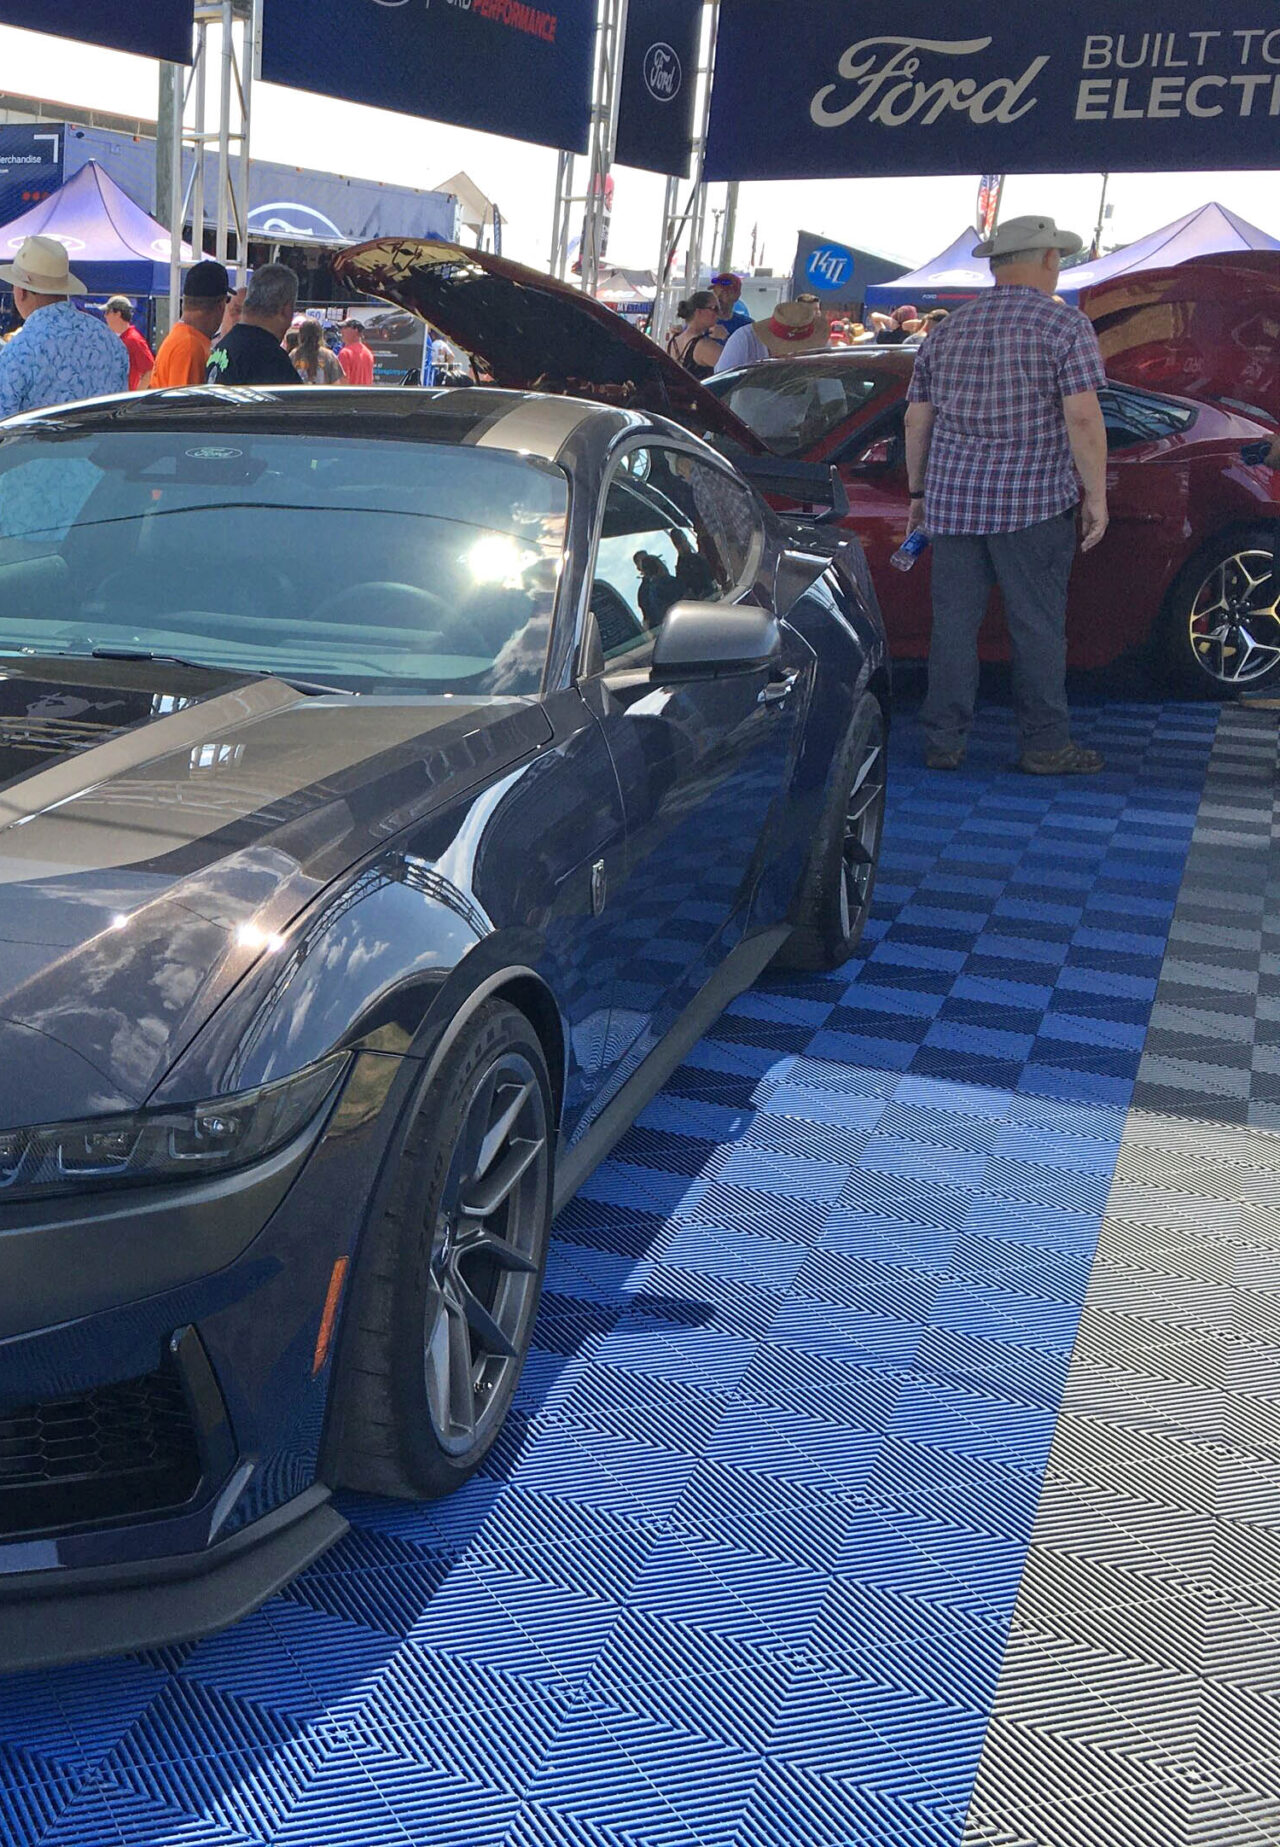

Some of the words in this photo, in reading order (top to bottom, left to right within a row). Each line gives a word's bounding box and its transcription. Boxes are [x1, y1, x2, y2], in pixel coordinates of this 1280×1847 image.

[648, 47, 677, 95] Ford
[1082, 31, 1221, 70] BUILT
[810, 36, 1051, 127] Ford
